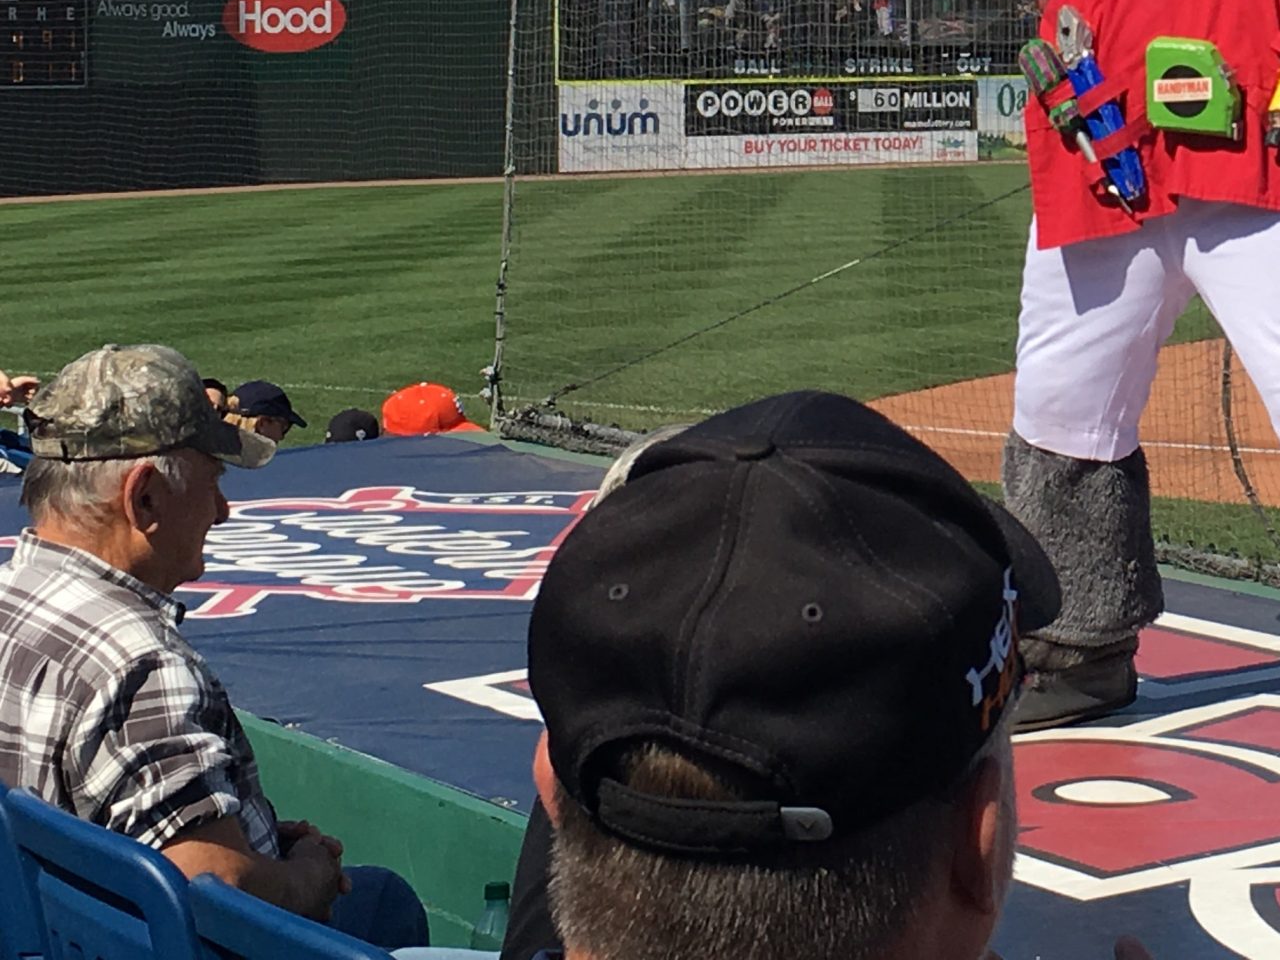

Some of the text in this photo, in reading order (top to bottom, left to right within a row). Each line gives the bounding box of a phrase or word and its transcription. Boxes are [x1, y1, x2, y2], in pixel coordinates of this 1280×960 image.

[9, 6, 75, 21] R H E
[97, 0, 148, 20] Always
[239, 0, 332, 34] Hood
[162, 21, 217, 40] Always
[844, 57, 914, 74] STRIKE
[955, 57, 992, 72] OUT
[874, 92, 899, 108] 60
[903, 91, 971, 108] MILLION
[561, 109, 660, 137] unum
[744, 136, 923, 154] BUY YOUR TICKET TODAY!
[448, 495, 554, 504] EST.
